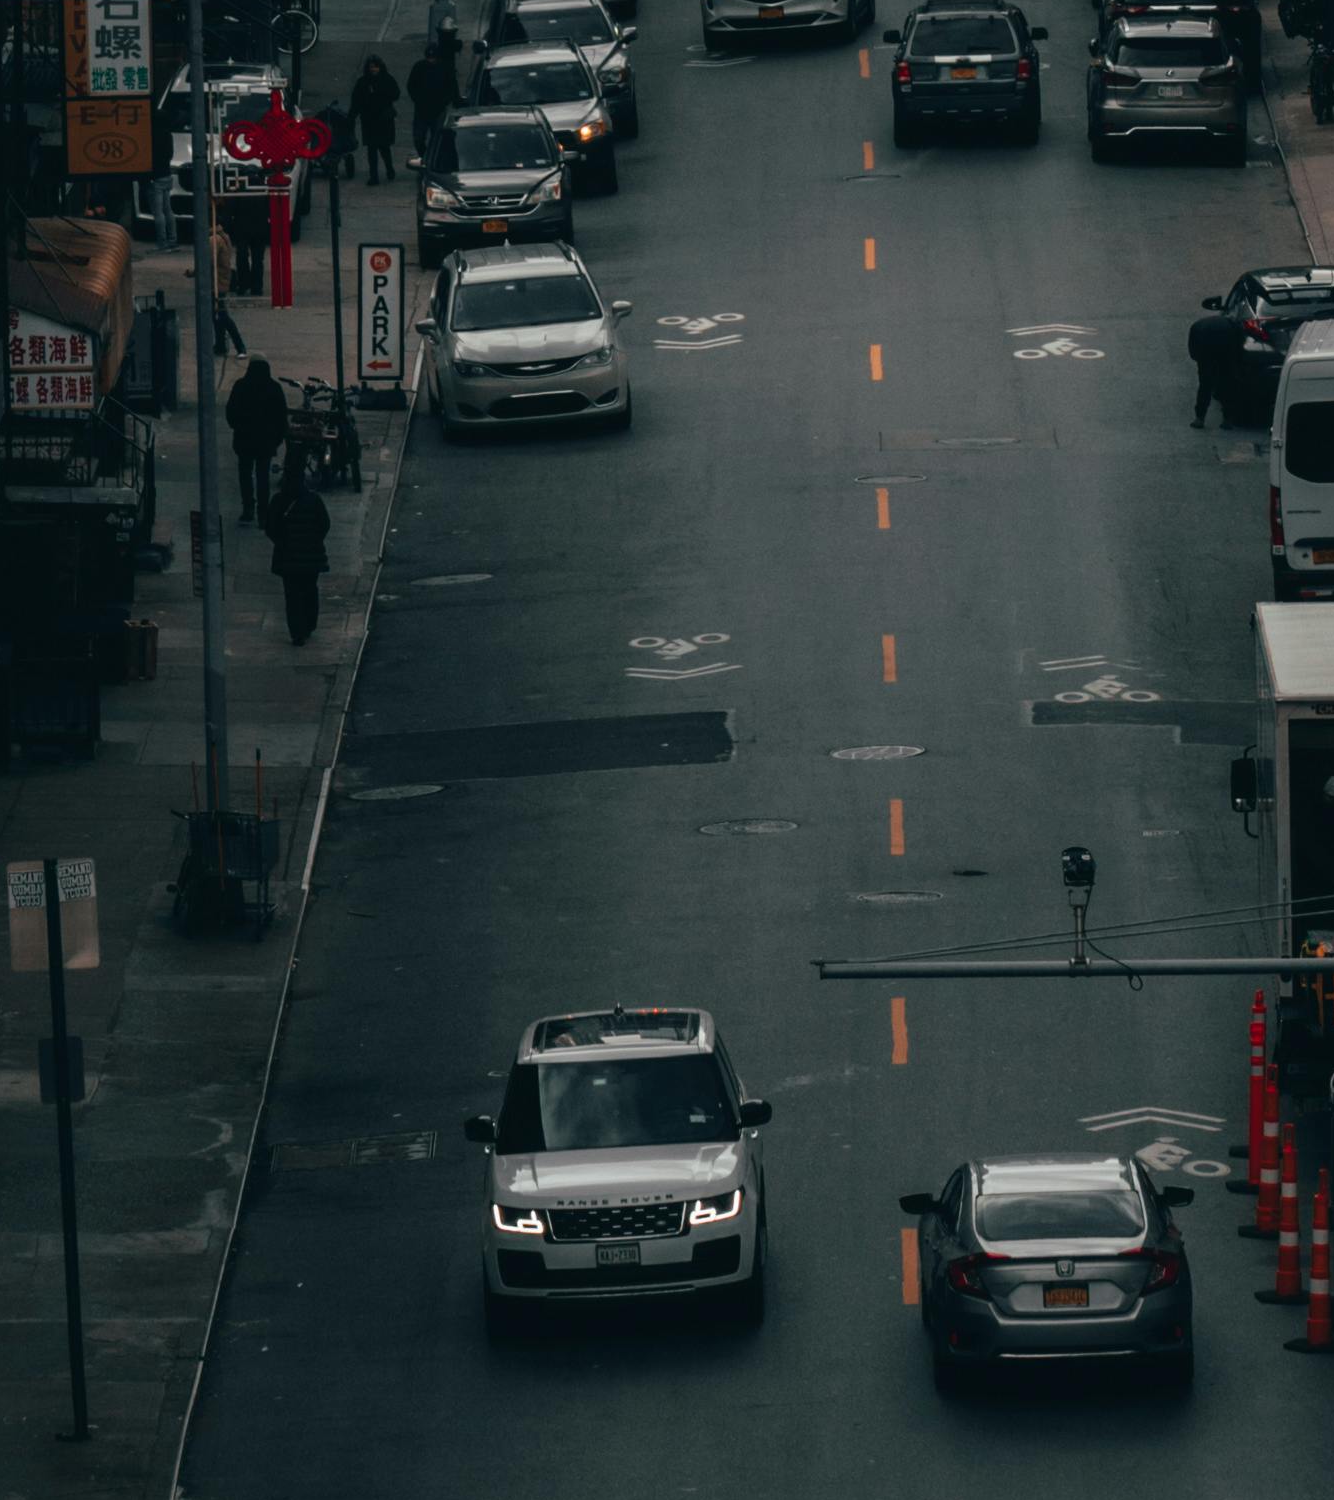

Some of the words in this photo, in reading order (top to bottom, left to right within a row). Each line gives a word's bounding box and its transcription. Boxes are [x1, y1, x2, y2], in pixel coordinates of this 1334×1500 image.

[97, 139, 123, 158] 98
[372, 275, 389, 356] PARK
[557, 1199, 609, 1207] RANGE
[620, 1193, 674, 1204] ROVER
